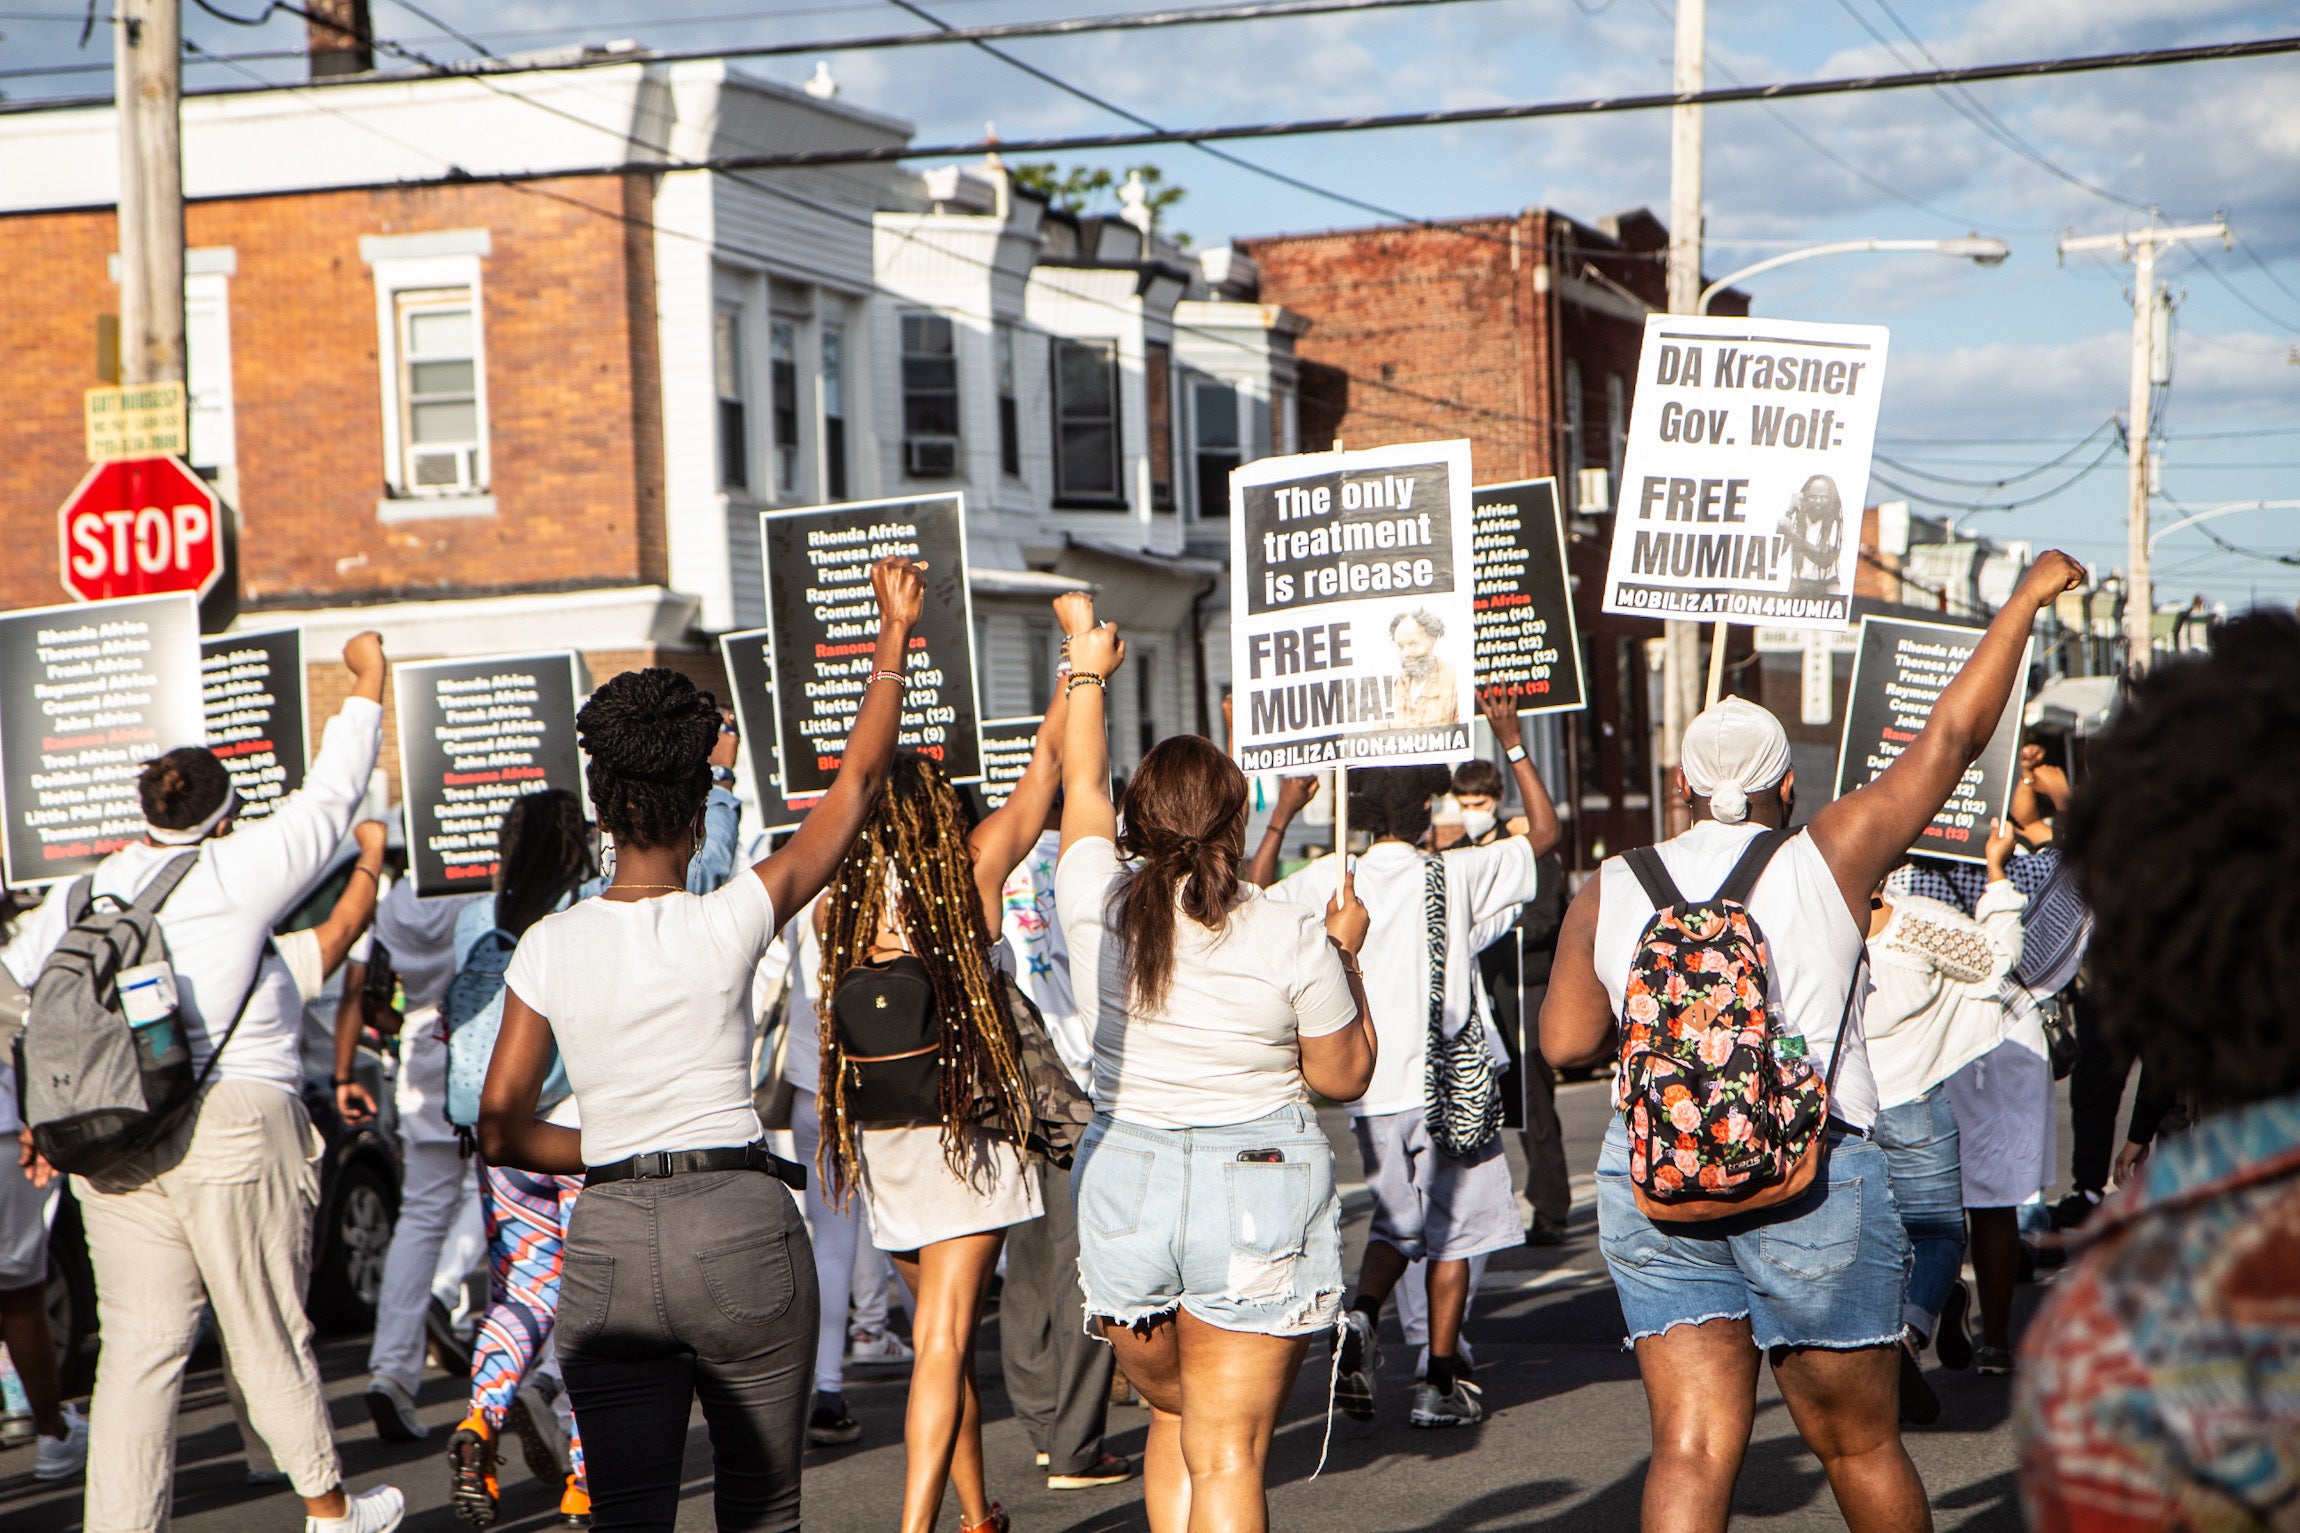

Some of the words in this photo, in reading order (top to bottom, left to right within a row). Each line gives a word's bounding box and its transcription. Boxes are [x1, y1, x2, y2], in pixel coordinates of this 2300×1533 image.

[1656, 344, 1702, 387] DA
[1713, 348, 1866, 396] Krasner
[1659, 401, 1736, 445] Gov.
[1750, 405, 1845, 450] Wolf:
[1274, 486, 1331, 522] The
[1341, 475, 1415, 511] only
[1638, 475, 1749, 523] FREE
[1476, 502, 1518, 519] Africa
[807, 527, 867, 547] Rhonda
[867, 522, 917, 540] Africa
[1479, 518, 1522, 534] Africa
[72, 504, 209, 580] STOP
[1264, 513, 1432, 564] treatment
[1474, 534, 1516, 550] Africa
[807, 547, 869, 566] Theresa
[870, 541, 919, 559] Africa
[1488, 547, 1529, 563] Africa
[1631, 530, 1781, 581] MUMIA!
[818, 564, 863, 584] Frank
[1265, 571, 1295, 605] is
[1303, 558, 1434, 598] release
[1484, 563, 1525, 579] Africa
[805, 582, 875, 605] Raymond
[1477, 579, 1519, 595] Africa
[814, 600, 871, 621] Conrad
[1490, 593, 1531, 608] Africa
[1617, 588, 1844, 619] MOBILIZATION4MUMIA
[1509, 605, 1535, 622] (14)
[826, 622, 862, 640] John
[1480, 624, 1521, 640] Africa
[1521, 619, 1548, 636] (13)
[814, 642, 876, 658] Ramona
[1248, 622, 1353, 680] FREE
[1476, 640, 1517, 656] Africa
[1518, 635, 1544, 652] (12)
[1898, 638, 1948, 657] Rhonda
[1491, 653, 1532, 669] Africa
[1533, 648, 1559, 665] (12)
[1894, 653, 1946, 672] Theresa
[813, 662, 849, 678] Tree
[1531, 664, 1551, 680] (9)
[1899, 669, 1937, 686] Frank
[804, 679, 863, 698] Delisha
[914, 669, 943, 688] (13)
[1525, 680, 1550, 696] (13)
[813, 699, 858, 715] Netta
[909, 689, 938, 708] (12)
[1250, 675, 1396, 736] MUMIA!
[799, 718, 842, 736] Little
[926, 706, 955, 725] (12)
[922, 725, 945, 744] (9)
[1243, 729, 1467, 771] MOBILIZATION4MUMIA
[1962, 798, 1987, 815] (12)
[1955, 812, 1975, 828] (9)
[1945, 826, 1969, 842] (13)
